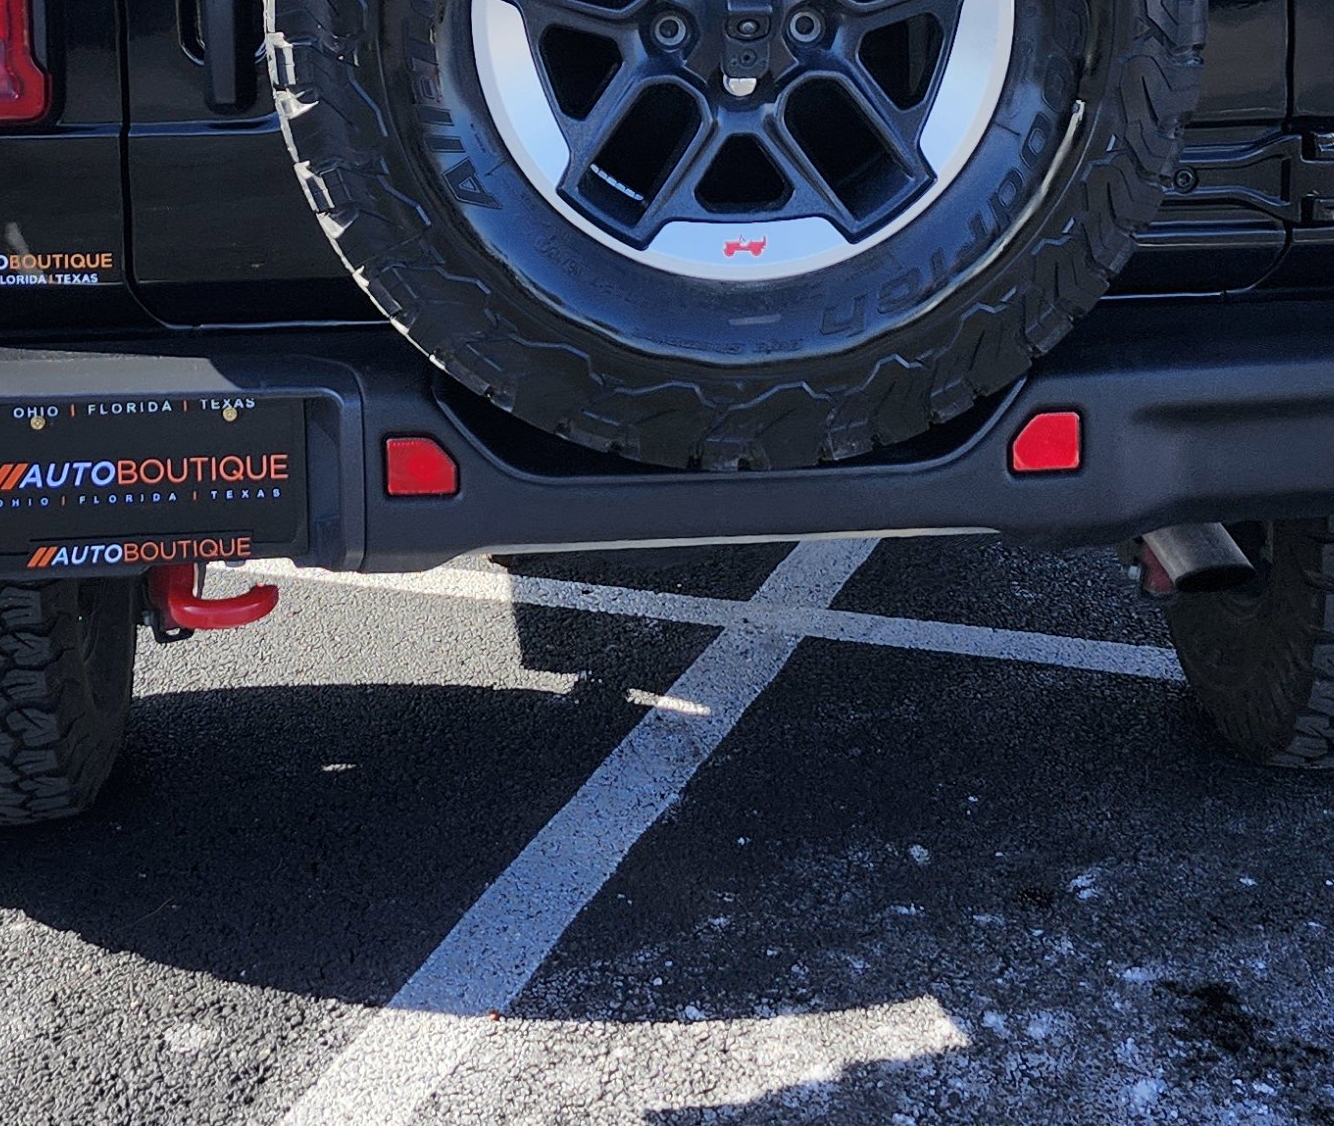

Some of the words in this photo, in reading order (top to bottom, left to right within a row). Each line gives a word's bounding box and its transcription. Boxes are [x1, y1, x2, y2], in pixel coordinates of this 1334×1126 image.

[55, 273, 98, 284] TEXAS
[13, 405, 59, 419] OHIO
[88, 400, 173, 415] FLORIDA
[200, 397, 256, 410] TEXAS
[18, 454, 289, 490] AUTOBOUTIQUE
[79, 492, 177, 504] FLORIDA
[210, 488, 281, 499] TEXAS
[50, 537, 252, 566] AUTOBOUTIQUE
